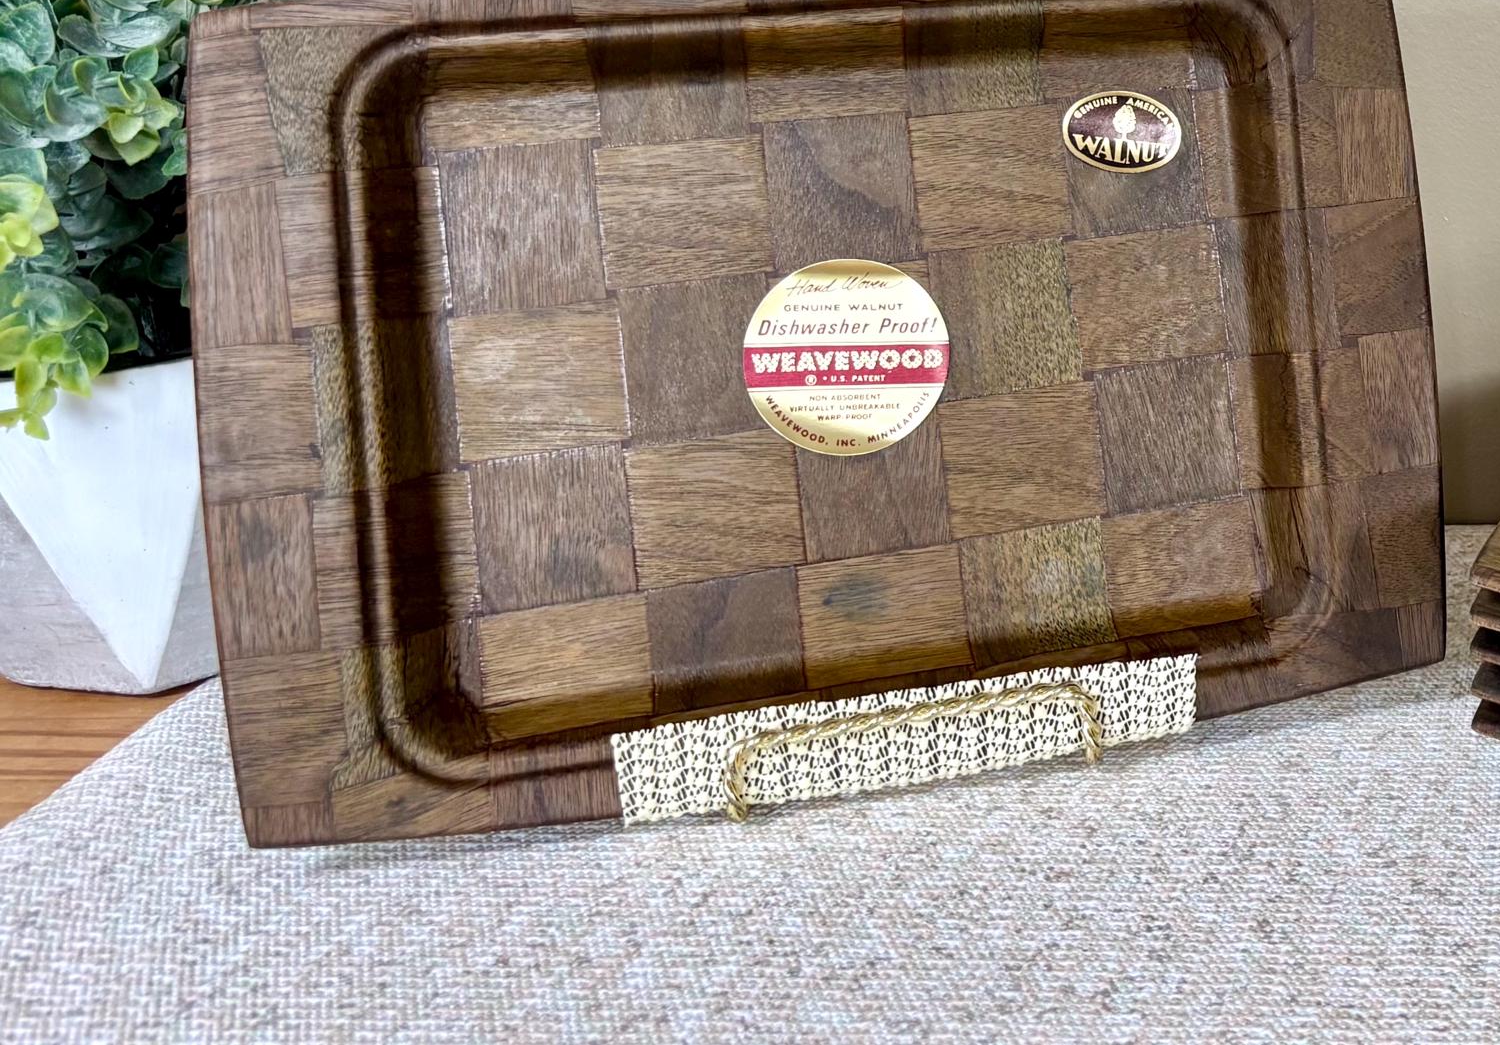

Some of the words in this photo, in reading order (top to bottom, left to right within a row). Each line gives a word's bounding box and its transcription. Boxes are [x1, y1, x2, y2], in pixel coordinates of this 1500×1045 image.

[1073, 96, 1118, 119] GENUINE
[1072, 133, 1171, 164] WALNUT
[786, 278, 837, 297] Hand
[842, 272, 903, 291] Woven
[784, 304, 841, 312] GENUINE
[848, 303, 904, 311] WALNUT
[758, 319, 870, 336] Dishwasher
[879, 317, 938, 334] Proof!
[751, 348, 944, 373] WEAVEWOOD
[831, 374, 848, 383] U.S.
[852, 374, 886, 382] PATENT
[831, 393, 881, 401] ABSORBENT
[836, 438, 861, 447] INC.
[867, 392, 930, 444] MINNEAPOLIS
